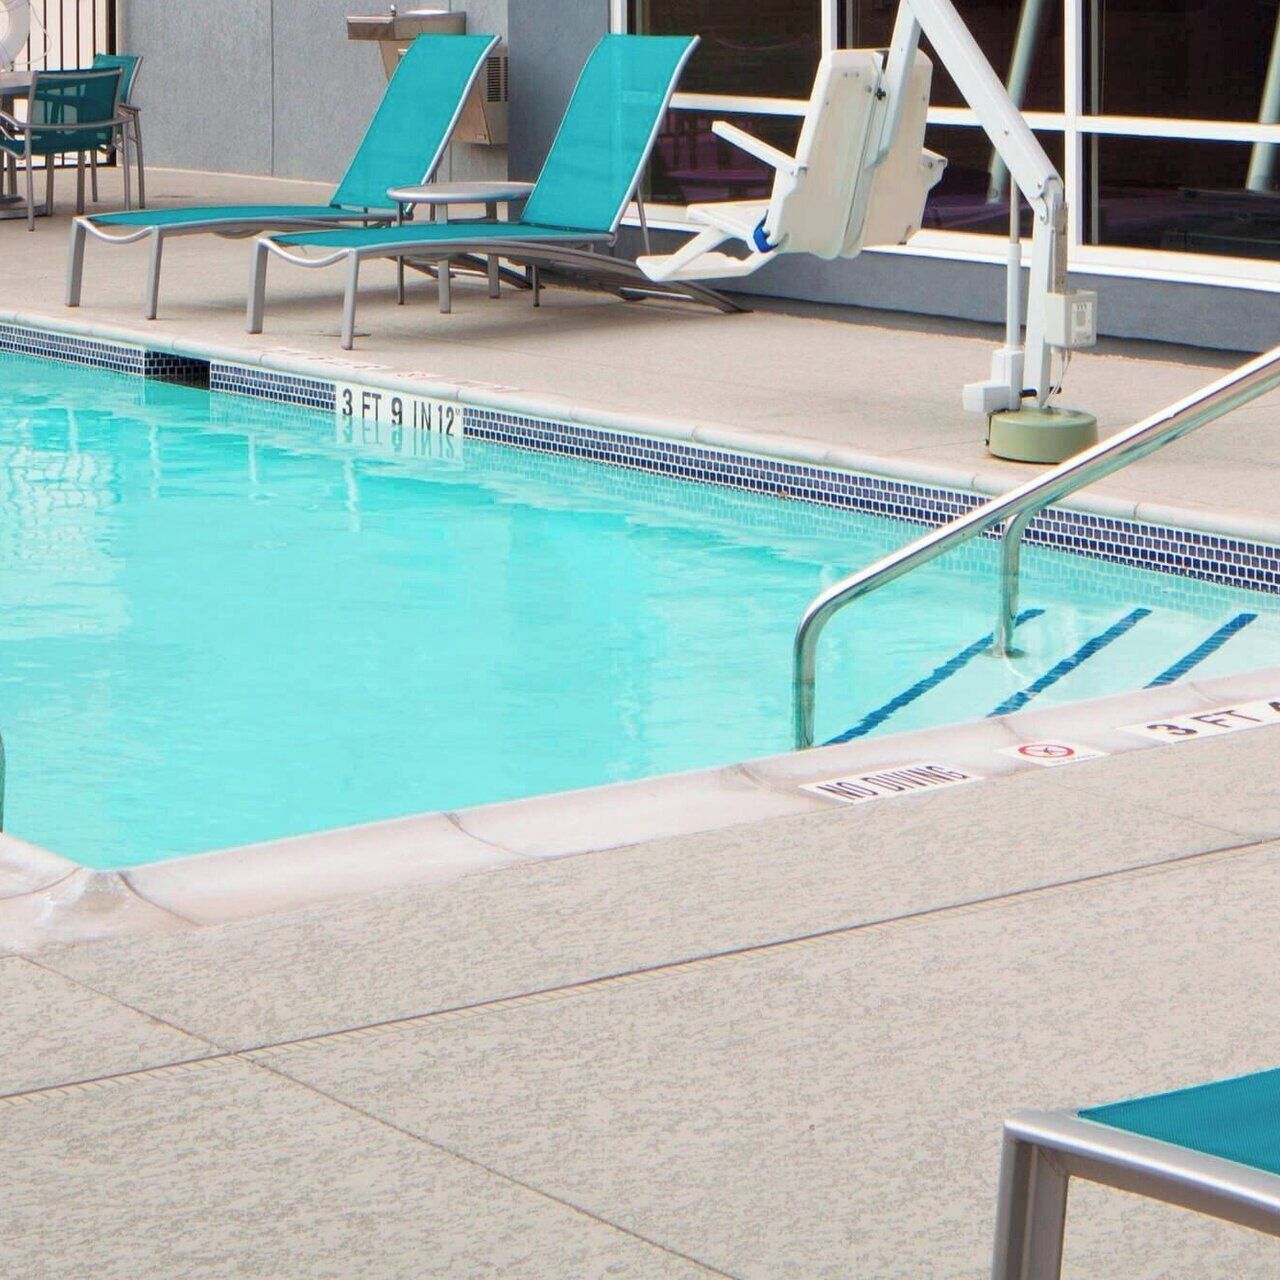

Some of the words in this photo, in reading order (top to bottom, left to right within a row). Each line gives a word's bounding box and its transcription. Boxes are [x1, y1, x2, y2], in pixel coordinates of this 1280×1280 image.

[342, 387, 353, 417] 3
[361, 391, 382, 421] FT
[391, 396, 404, 426] 9
[413, 400, 432, 431] IN
[1146, 723, 1198, 736] 3
[1190, 709, 1263, 728] FT
[817, 781, 879, 801] NO
[863, 765, 968, 793] DIVING
